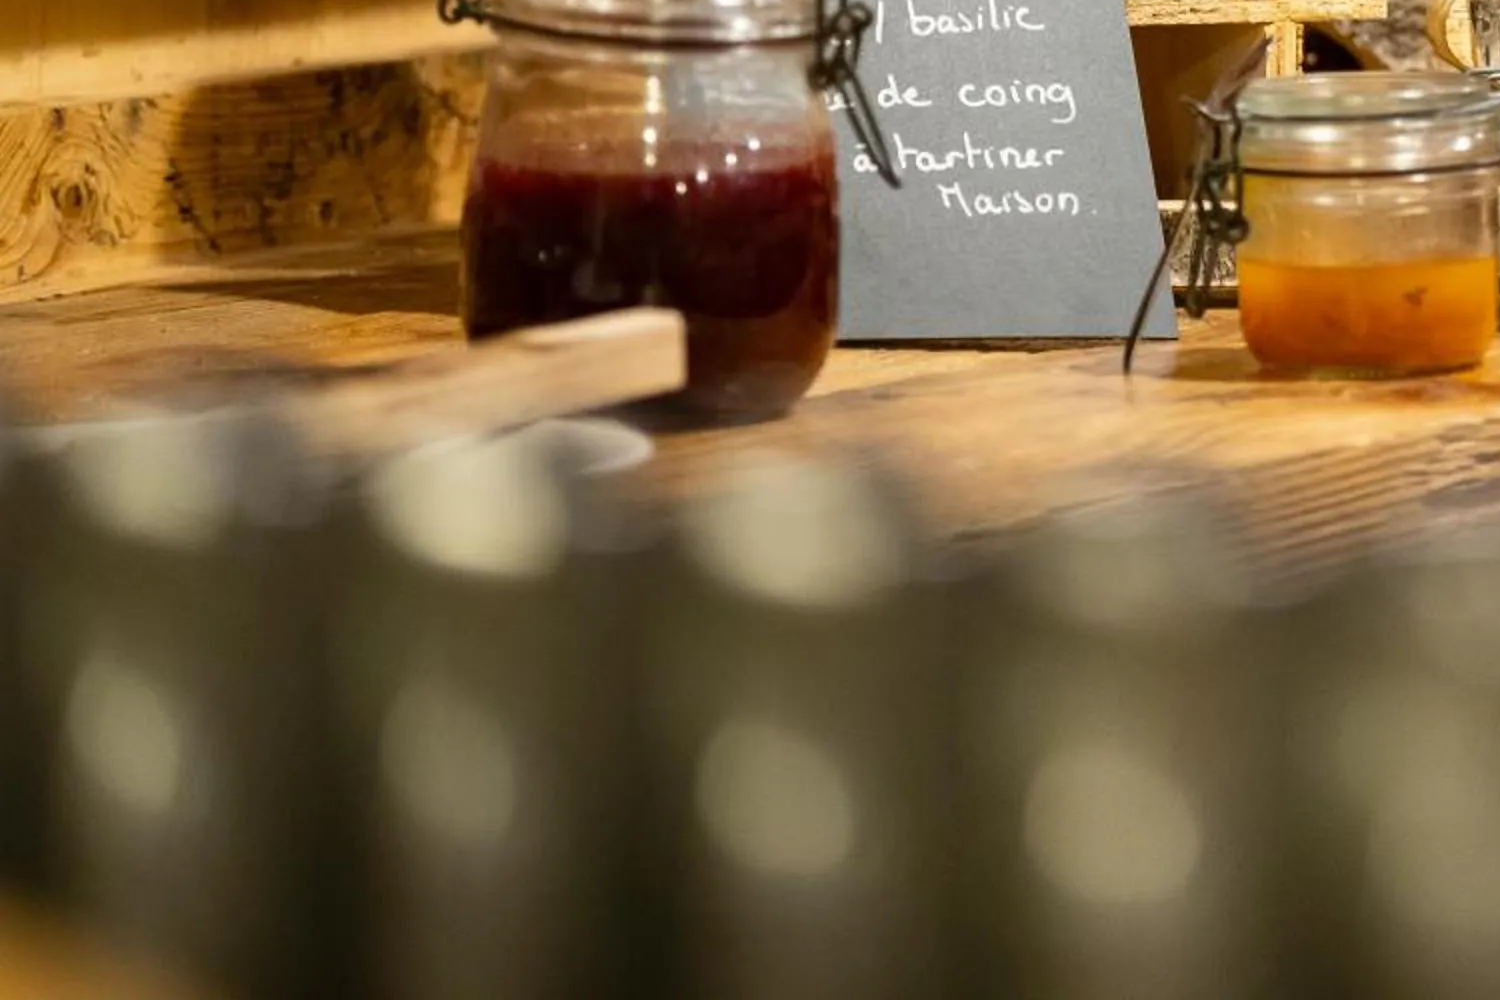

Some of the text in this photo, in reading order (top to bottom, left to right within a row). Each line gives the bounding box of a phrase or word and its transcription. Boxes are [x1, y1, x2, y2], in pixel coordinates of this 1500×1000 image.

[878, 73, 933, 108] de
[958, 80, 1076, 123] coing
[892, 130, 1065, 171] tartiner
